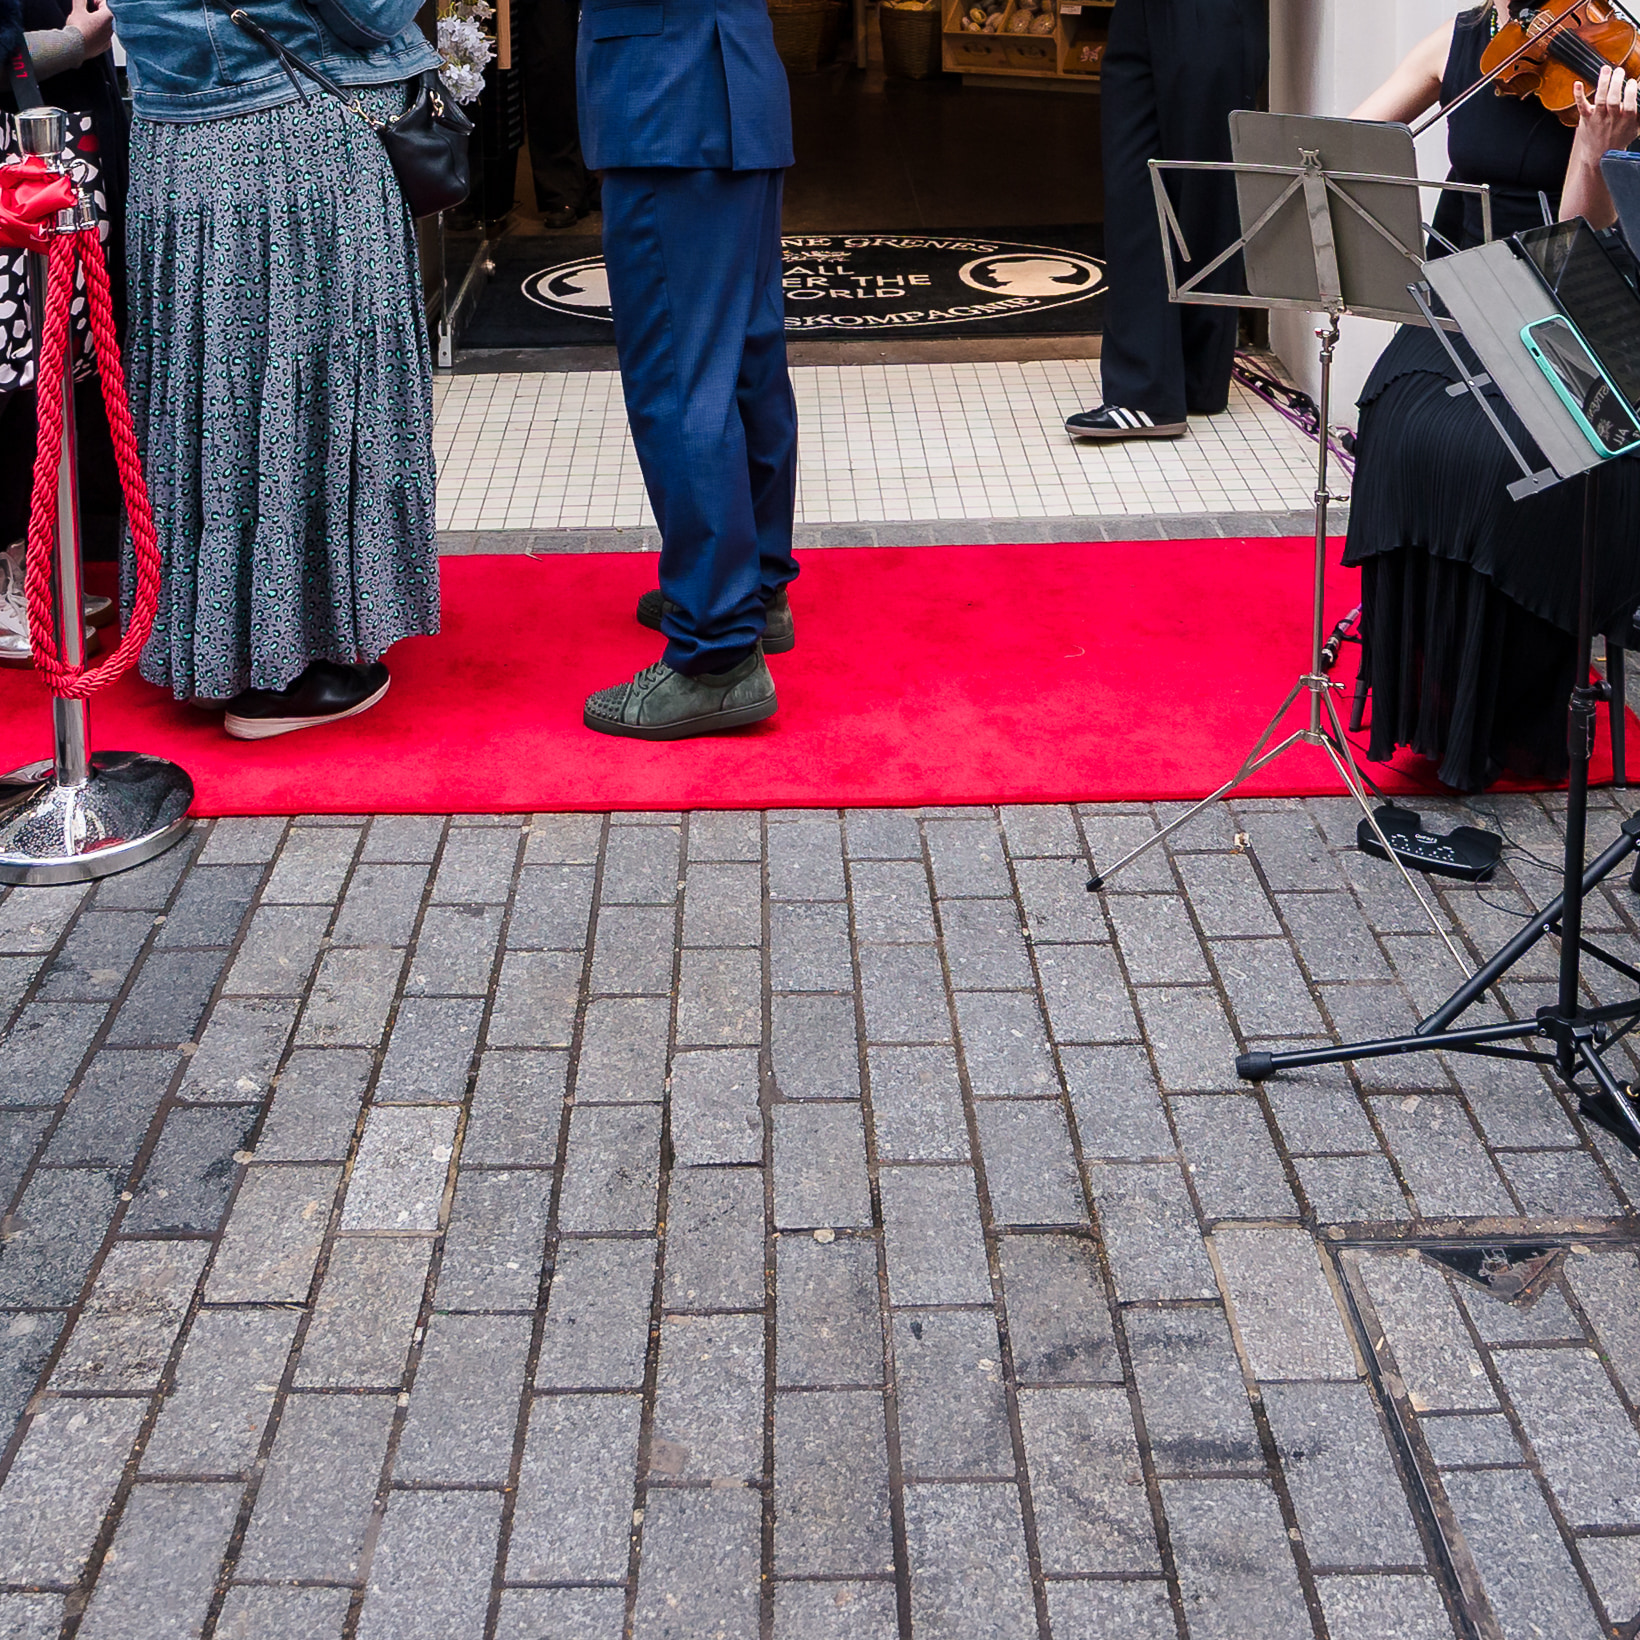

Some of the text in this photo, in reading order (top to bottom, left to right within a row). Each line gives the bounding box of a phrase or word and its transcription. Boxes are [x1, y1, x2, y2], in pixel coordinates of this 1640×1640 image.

[843, 237, 999, 253] GRENES
[783, 264, 855, 276] ALL
[782, 273, 932, 288] ER THE
[785, 288, 907, 300] ORLD
[783, 297, 1042, 325] SKOMPAGNIE
